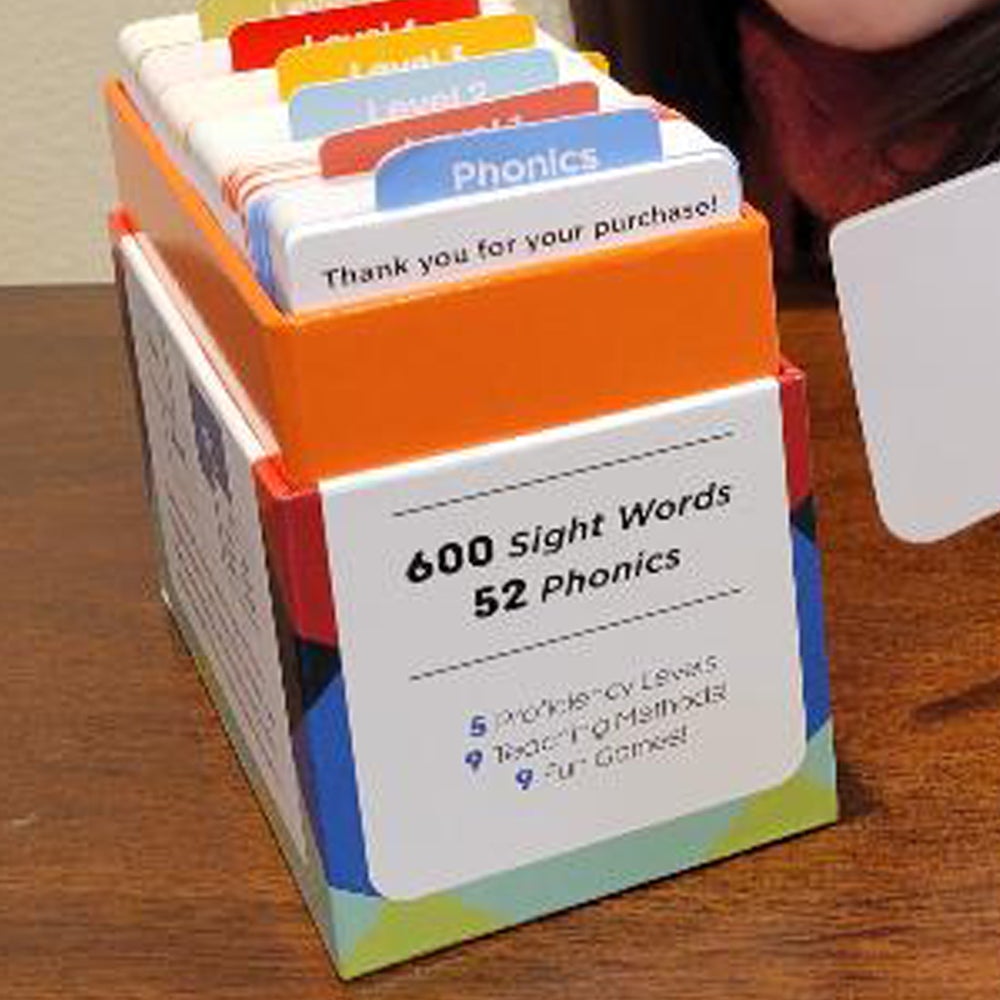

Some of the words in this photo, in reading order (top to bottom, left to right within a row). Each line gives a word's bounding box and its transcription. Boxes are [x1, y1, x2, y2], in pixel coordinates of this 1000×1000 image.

[451, 146, 598, 192] Phonics
[322, 254, 410, 290] Thank
[418, 247, 470, 276] you
[477, 236, 517, 262] for
[523, 224, 585, 254] your
[594, 193, 718, 241] purchase!
[405, 534, 494, 584] 600
[507, 513, 605, 557] Sight
[618, 481, 733, 531] Words
[473, 578, 529, 619] 52
[540, 547, 682, 603] Phonics
[469, 714, 488, 738] 5
[465, 749, 484, 773] 9
[515, 767, 534, 791] 9
